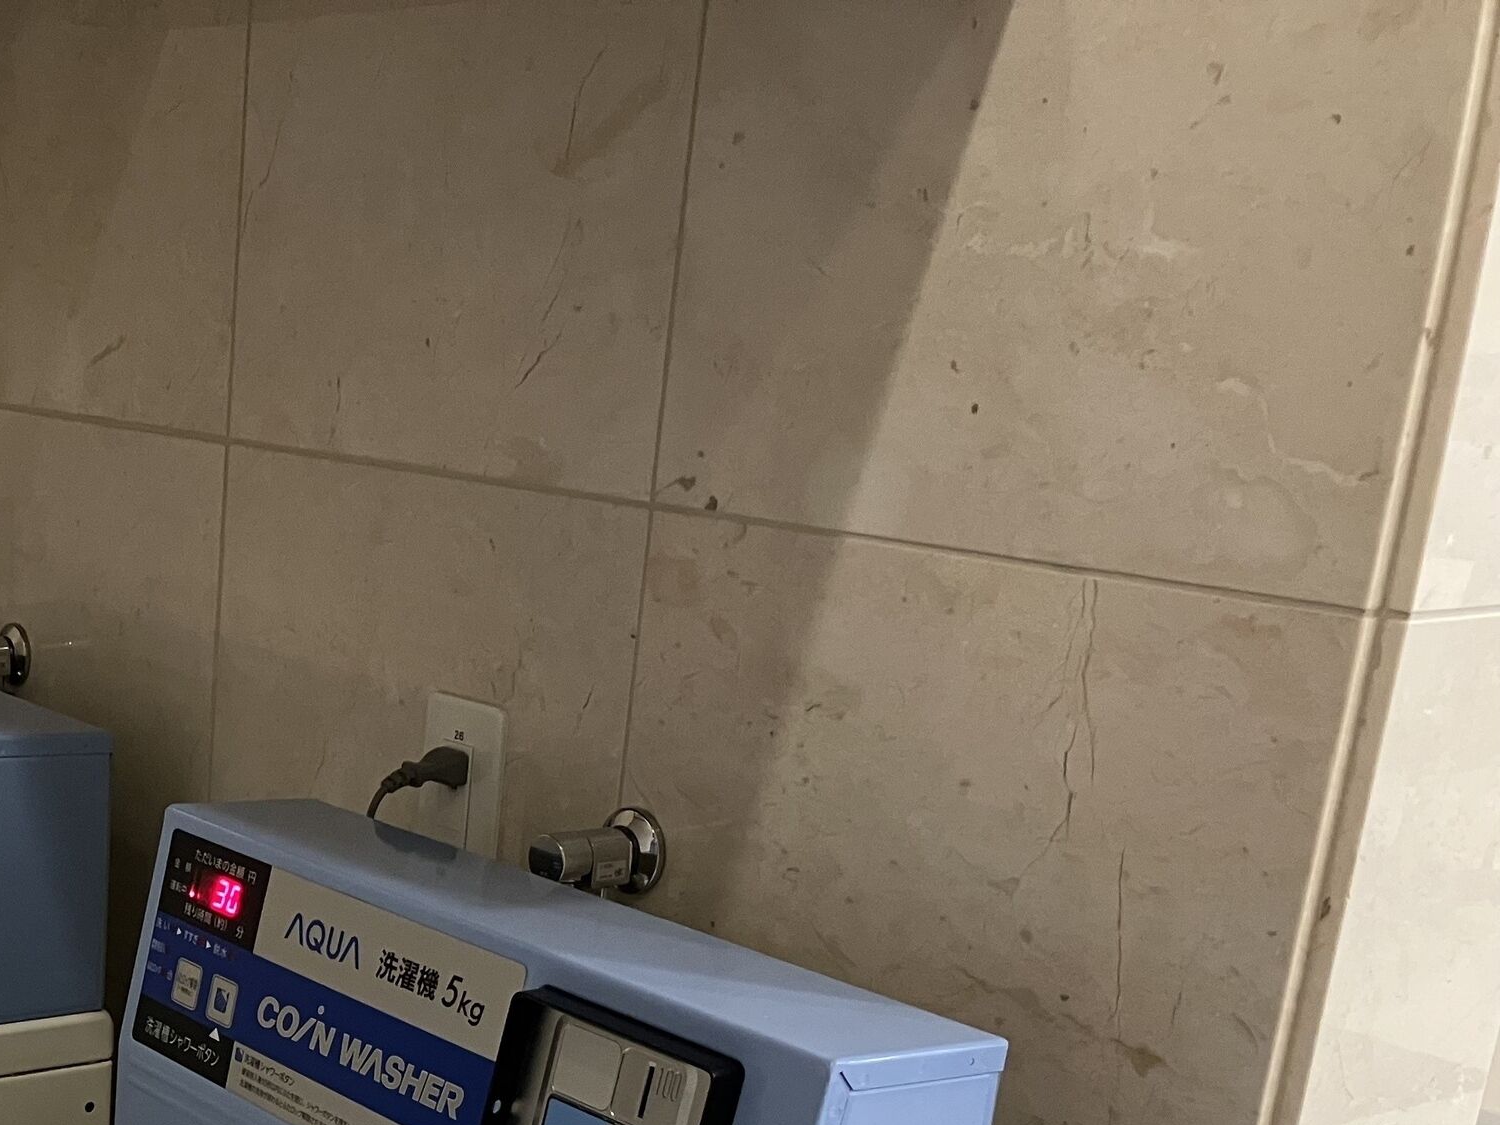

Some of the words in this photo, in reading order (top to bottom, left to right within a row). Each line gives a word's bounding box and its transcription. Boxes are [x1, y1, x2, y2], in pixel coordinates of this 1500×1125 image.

[284, 913, 361, 971] AQUA
[375, 947, 440, 1003] 洗濯機
[440, 974, 486, 1027] 5kg
[256, 995, 337, 1058] COIN
[339, 1030, 467, 1122] WASHER
